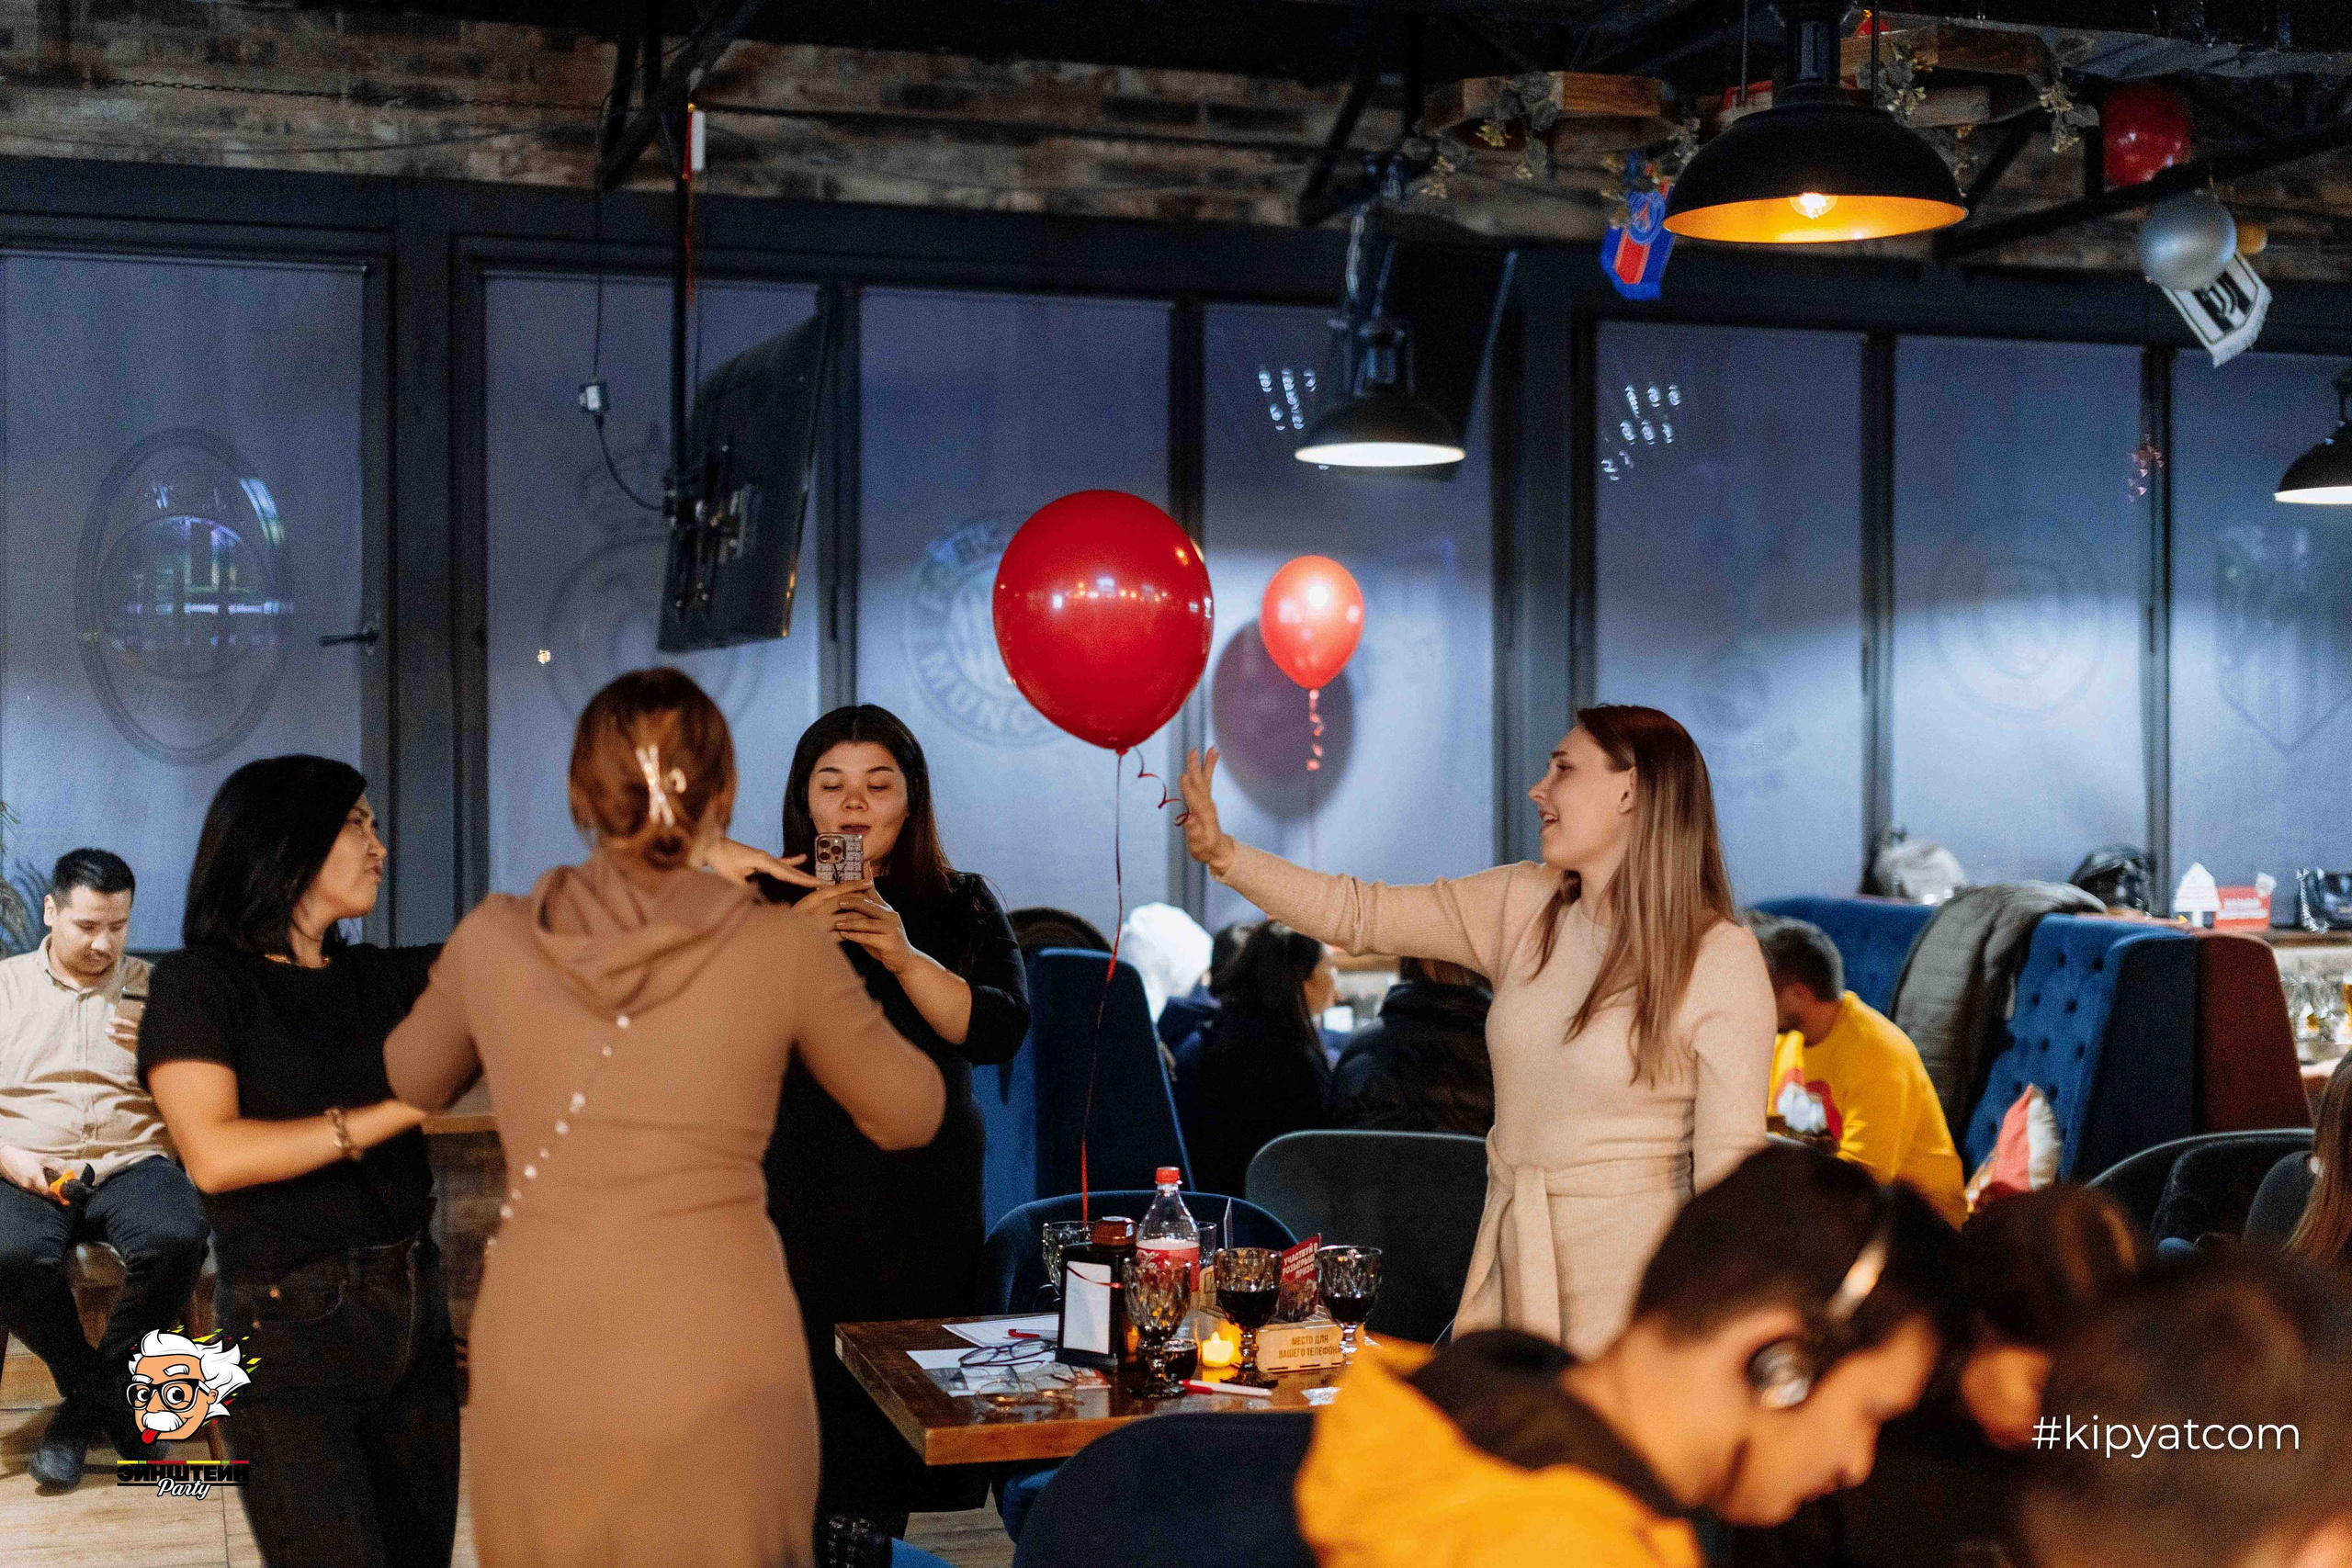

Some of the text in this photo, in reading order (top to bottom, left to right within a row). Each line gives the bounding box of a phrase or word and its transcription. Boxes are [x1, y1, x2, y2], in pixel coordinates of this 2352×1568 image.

[1283, 1243, 1313, 1265] УЧАСТВУЙ
[1295, 1262, 1316, 1279] ПРИЗО
[1292, 1334, 1329, 1345] МЕСТО ДЛЯ
[1278, 1348, 1306, 1359] ВАШЕГО
